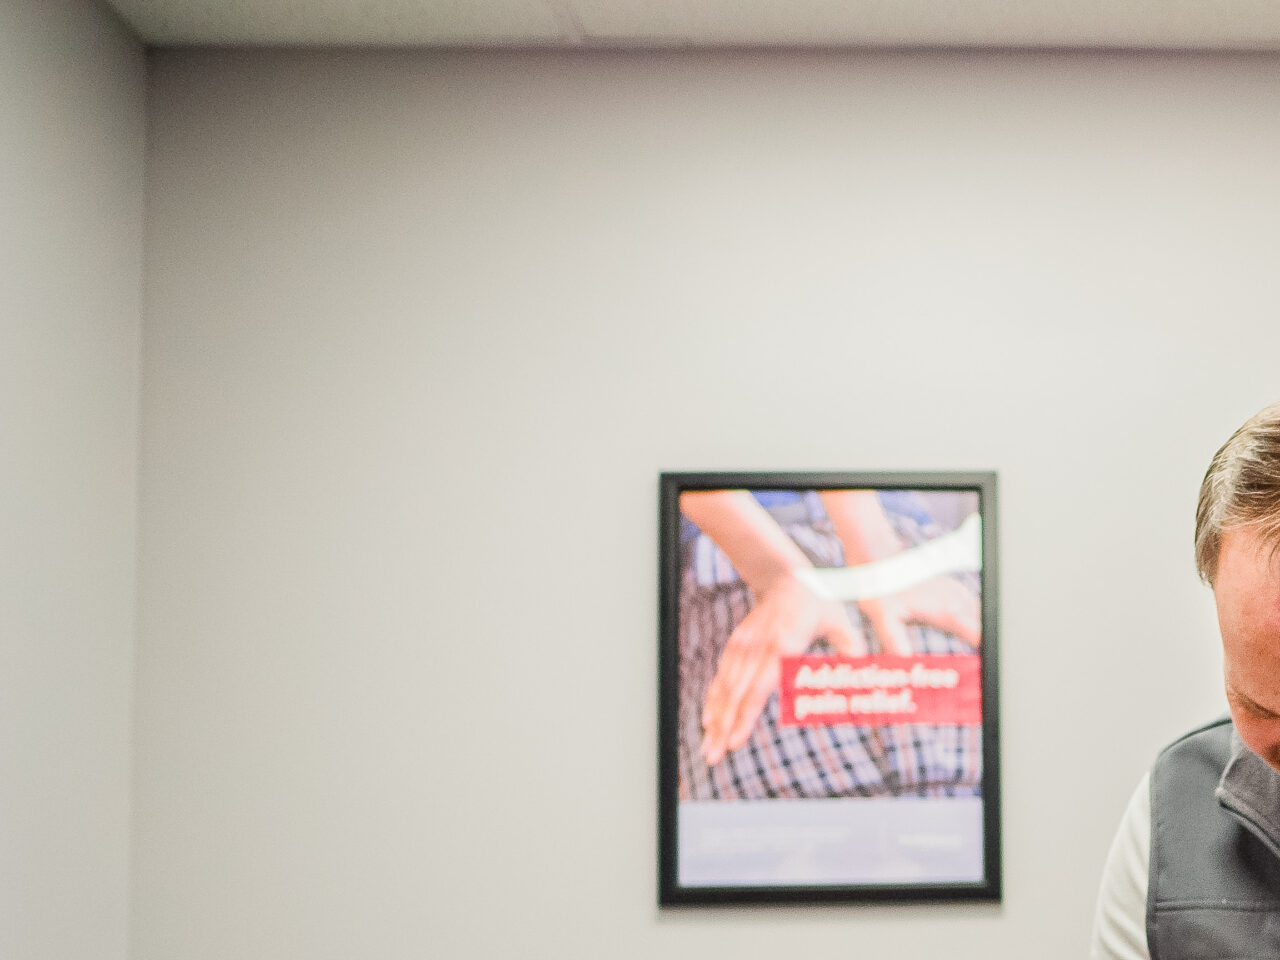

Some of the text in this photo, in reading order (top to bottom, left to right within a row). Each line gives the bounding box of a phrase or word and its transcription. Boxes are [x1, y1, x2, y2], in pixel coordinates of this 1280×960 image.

[795, 664, 959, 688] Addiction-free
[795, 690, 917, 720] pain relief.
